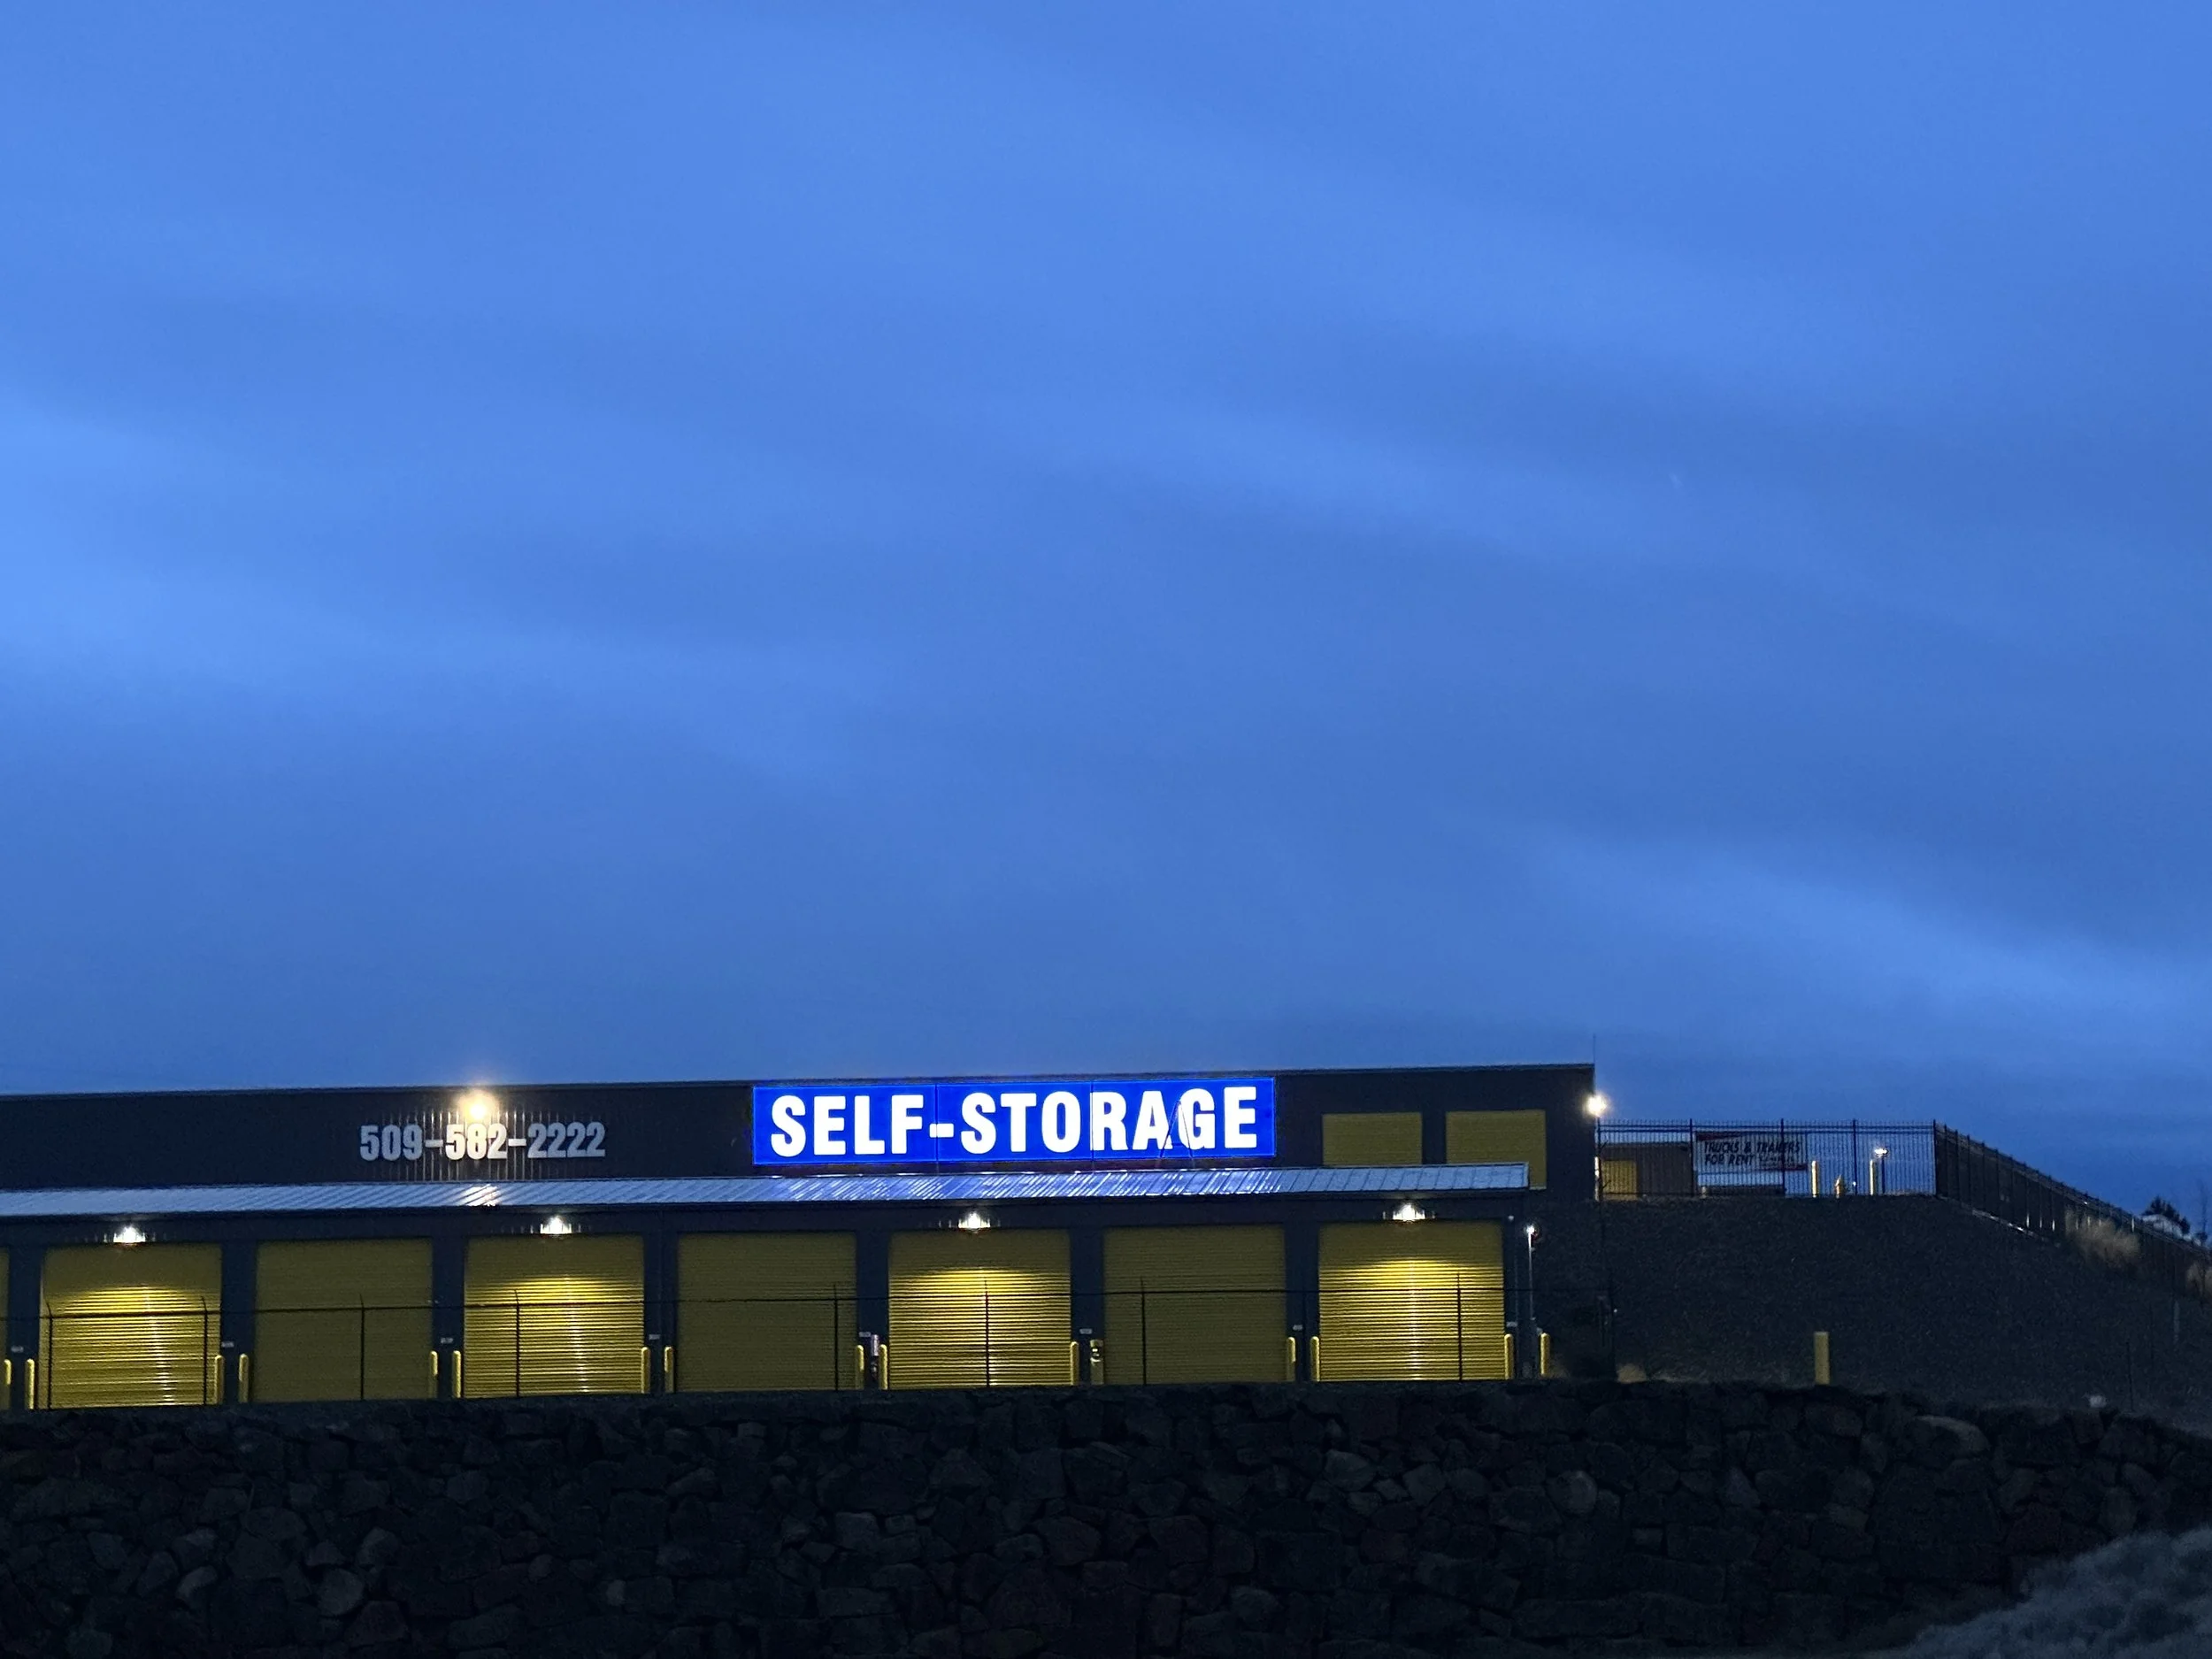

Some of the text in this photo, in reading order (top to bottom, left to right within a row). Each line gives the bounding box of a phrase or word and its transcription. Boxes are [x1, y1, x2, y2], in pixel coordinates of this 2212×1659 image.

[771, 1086, 1257, 1157] SELF-STORAGE
[359, 1121, 606, 1162] 509-582-2222
[1704, 1141, 1740, 1153] TRUCKS
[1744, 1141, 1751, 1154] &
[1704, 1153, 1724, 1165] FOR
[1728, 1154, 1755, 1166] RENT
